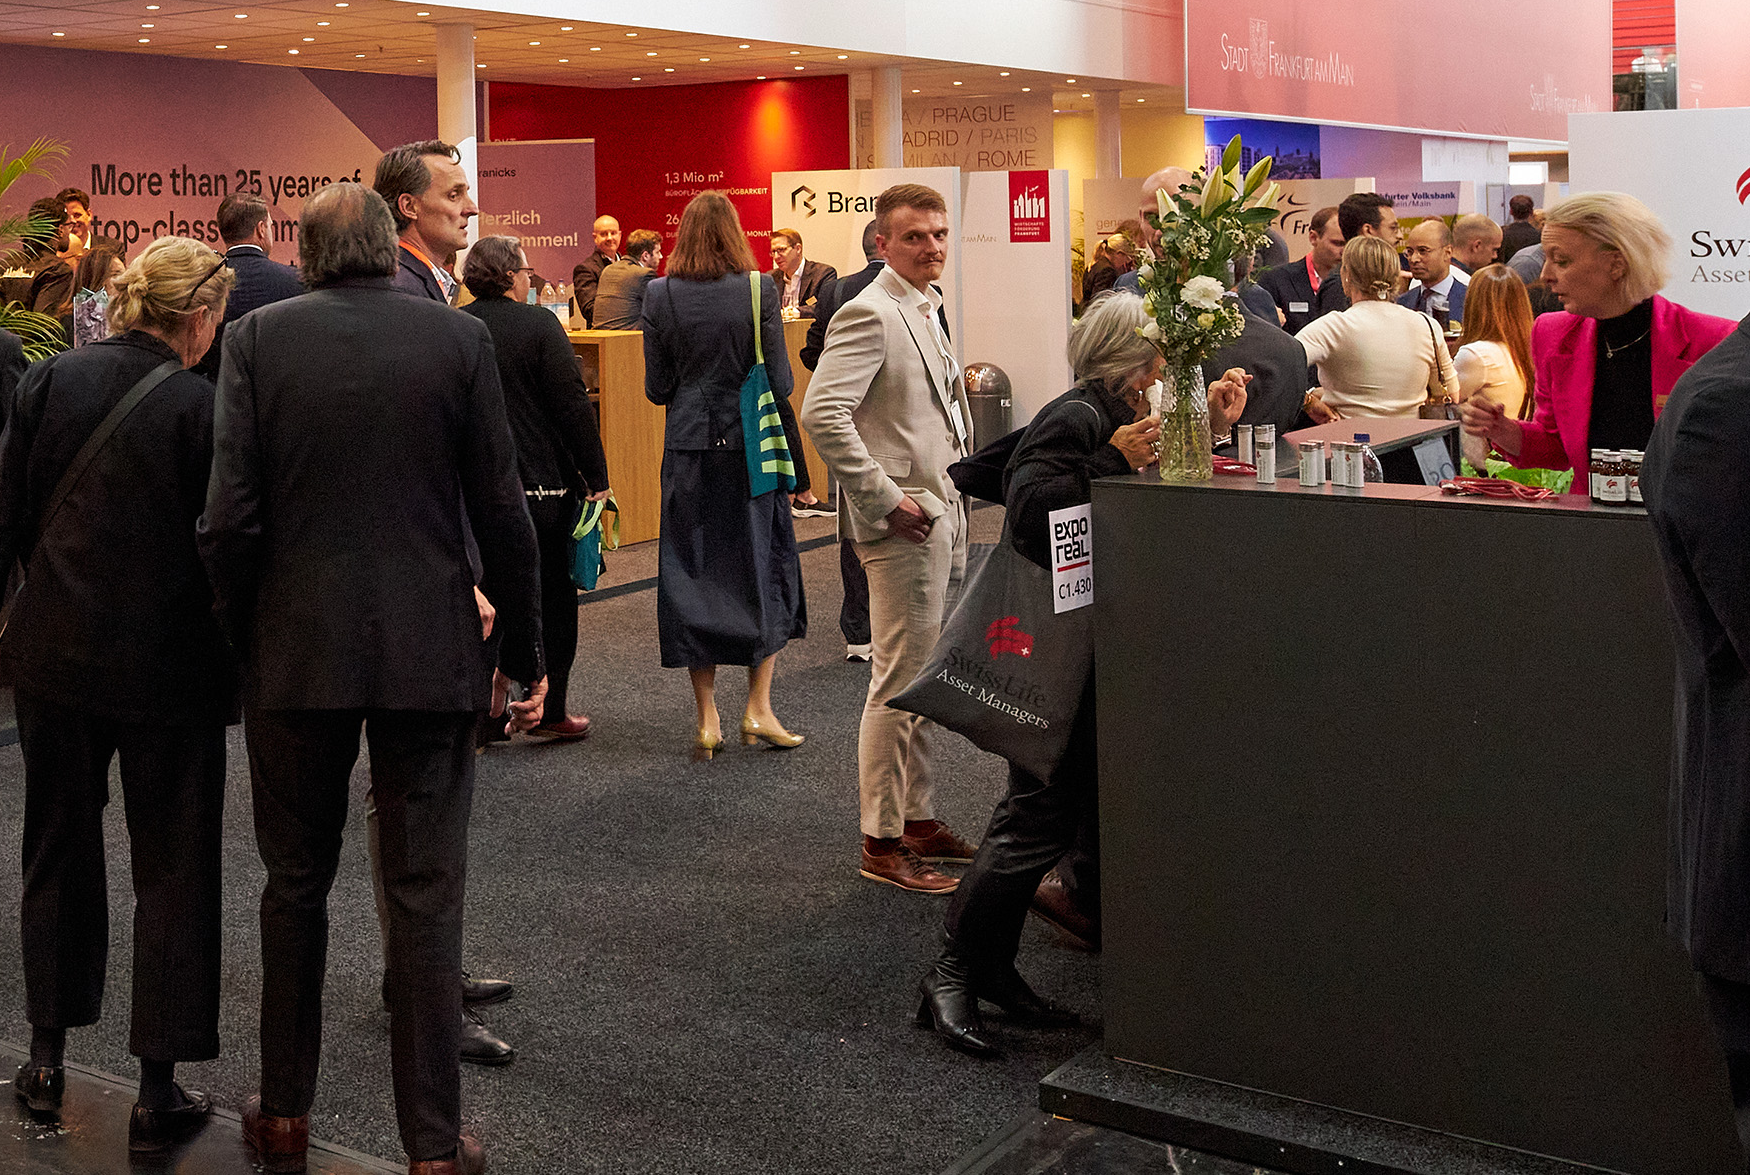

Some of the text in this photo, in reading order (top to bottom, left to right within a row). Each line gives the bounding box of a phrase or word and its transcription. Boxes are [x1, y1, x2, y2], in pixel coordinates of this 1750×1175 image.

[1221, 33, 1249, 72] STADT
[1269, 41, 1314, 80] FRANKFURT
[1328, 51, 1354, 86] MAIN
[933, 105, 1016, 124] PRAGUE
[902, 130, 959, 148] ADRID
[981, 126, 1038, 145] PARIS
[978, 150, 1036, 168] ROME
[91, 164, 163, 197] More
[170, 165, 228, 197] than
[235, 169, 263, 197] 25
[478, 168, 516, 178] ranicks
[665, 172, 680, 185] 1,3
[683, 171, 705, 183] Mio
[1412, 192, 1456, 200] Volksbank
[520, 232, 578, 247] mmen!
[1054, 517, 1088, 544] expo
[1058, 577, 1092, 599] C1.430
[936, 669, 1050, 729] Asset Managers
